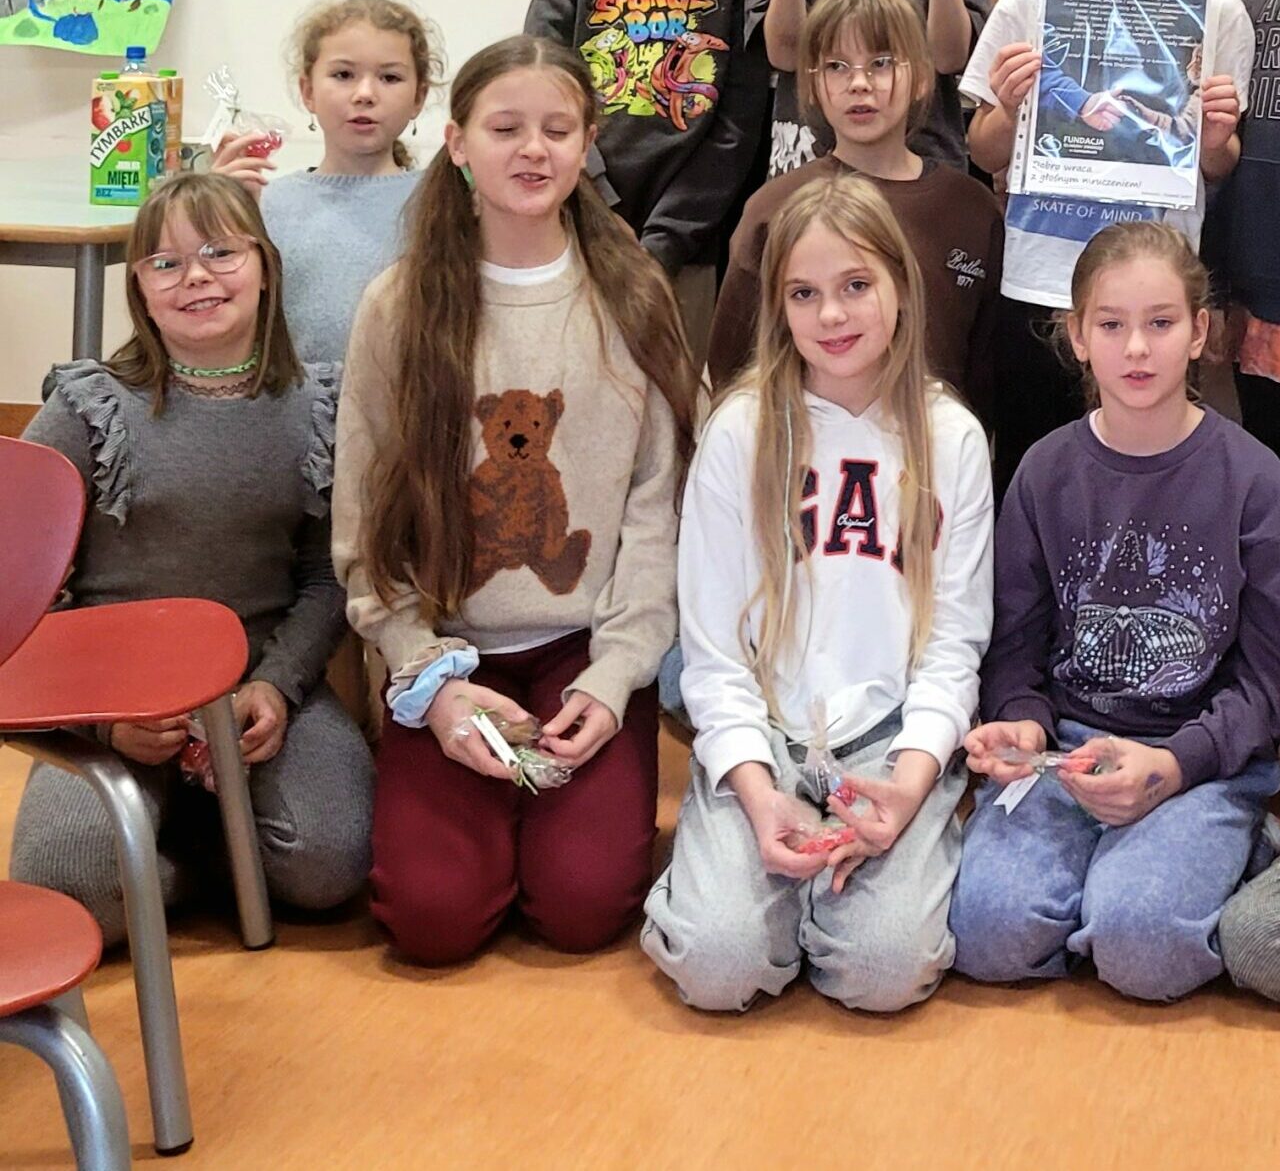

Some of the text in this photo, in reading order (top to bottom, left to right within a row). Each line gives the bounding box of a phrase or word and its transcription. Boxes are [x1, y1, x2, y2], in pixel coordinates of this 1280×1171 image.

[624, 9, 688, 43] BOB
[90, 111, 150, 161] TYMBARK
[1063, 135, 1105, 146] FUNDACJA
[107, 170, 140, 189] MIĘTA
[1032, 199, 1142, 223] SKATE OF MIND
[956, 275, 974, 288] 1971
